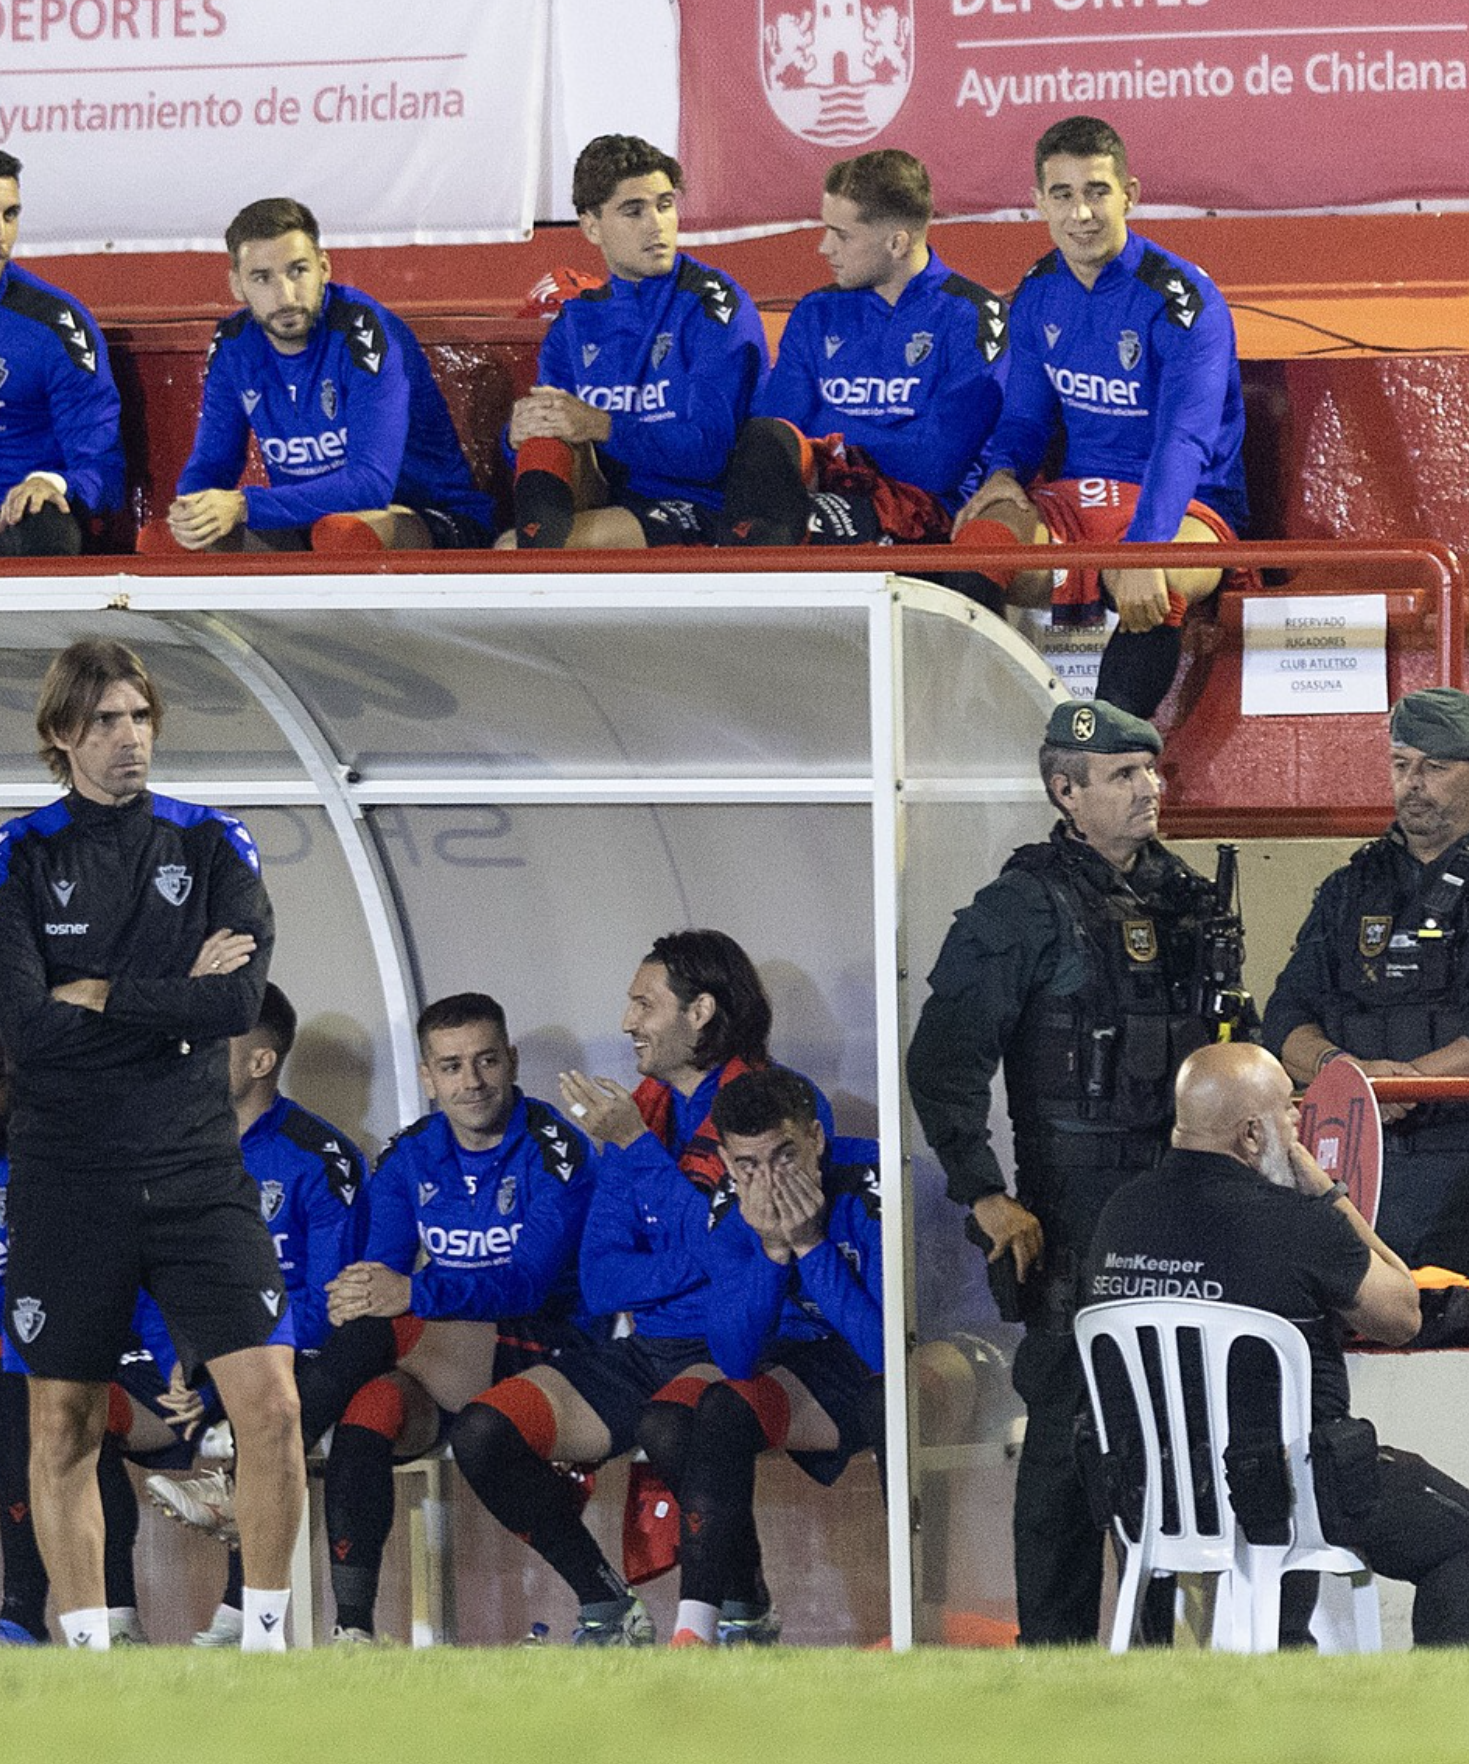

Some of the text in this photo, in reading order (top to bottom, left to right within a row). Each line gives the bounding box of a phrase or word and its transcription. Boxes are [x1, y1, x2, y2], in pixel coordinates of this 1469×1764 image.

[956, 50, 1467, 117] Ayuntamiento de Chiclana
[254, 87, 300, 127] de
[312, 82, 464, 124] Chiclana
[1285, 616, 1346, 628] RESERVADO
[1285, 636, 1347, 648] JUGADORES
[1281, 656, 1358, 669] CLUB ATLETICO
[1291, 679, 1342, 692] OSASUNA
[463, 1175, 478, 1196] 5
[1105, 1252, 1205, 1275] MenKeeper
[1093, 1275, 1224, 1300] SEGURIDAD
